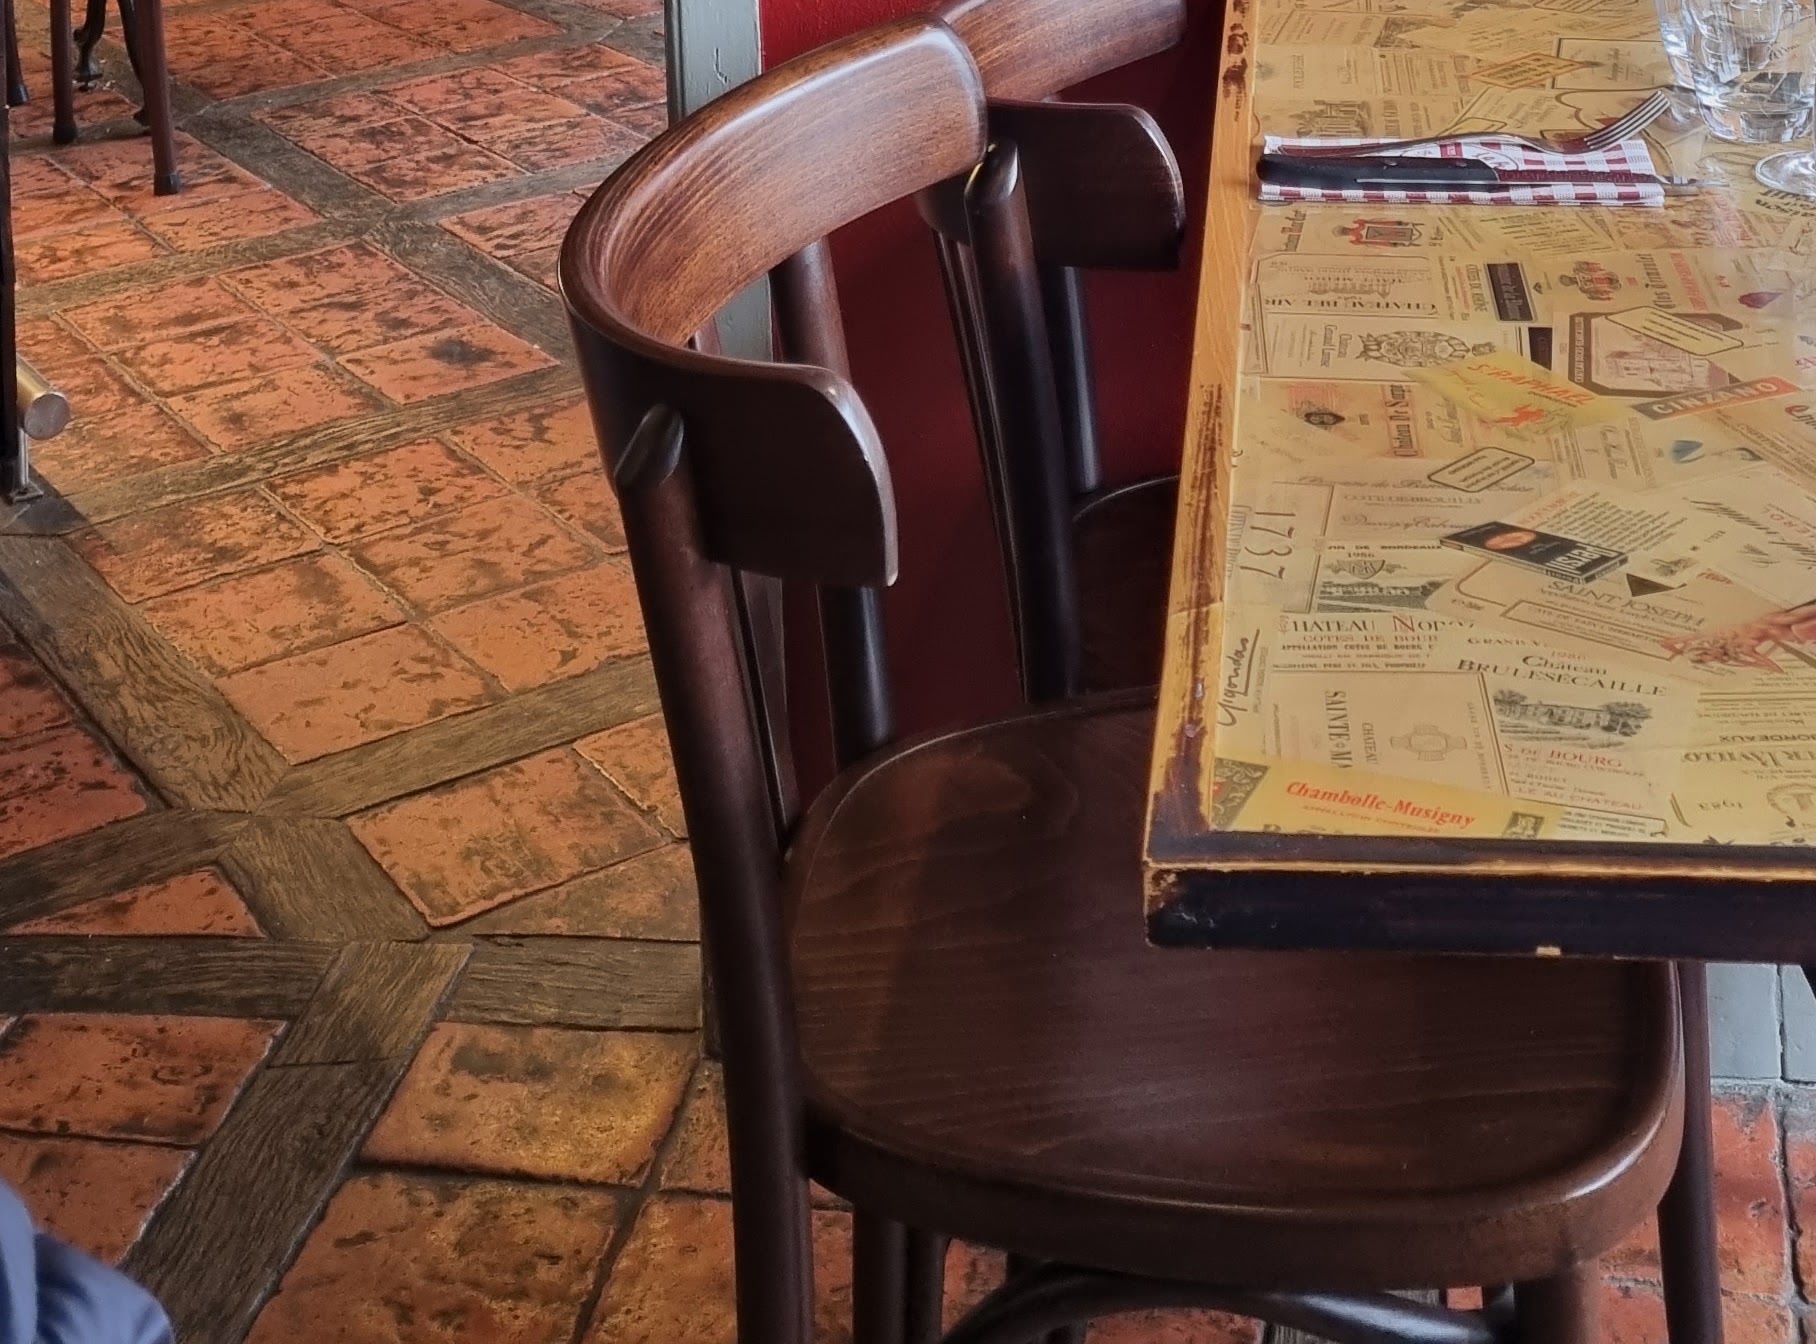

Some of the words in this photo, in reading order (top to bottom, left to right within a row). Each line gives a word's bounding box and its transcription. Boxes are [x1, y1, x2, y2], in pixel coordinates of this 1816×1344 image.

[1651, 381, 1778, 415] CINZANO
[1239, 511, 1297, 581] 1737
[1547, 580, 1622, 602] SAINT
[1622, 598, 1706, 627] JOSEPH
[1549, 749, 1624, 768] BOURG
[1285, 780, 1476, 831] Chambolle-Musigny
